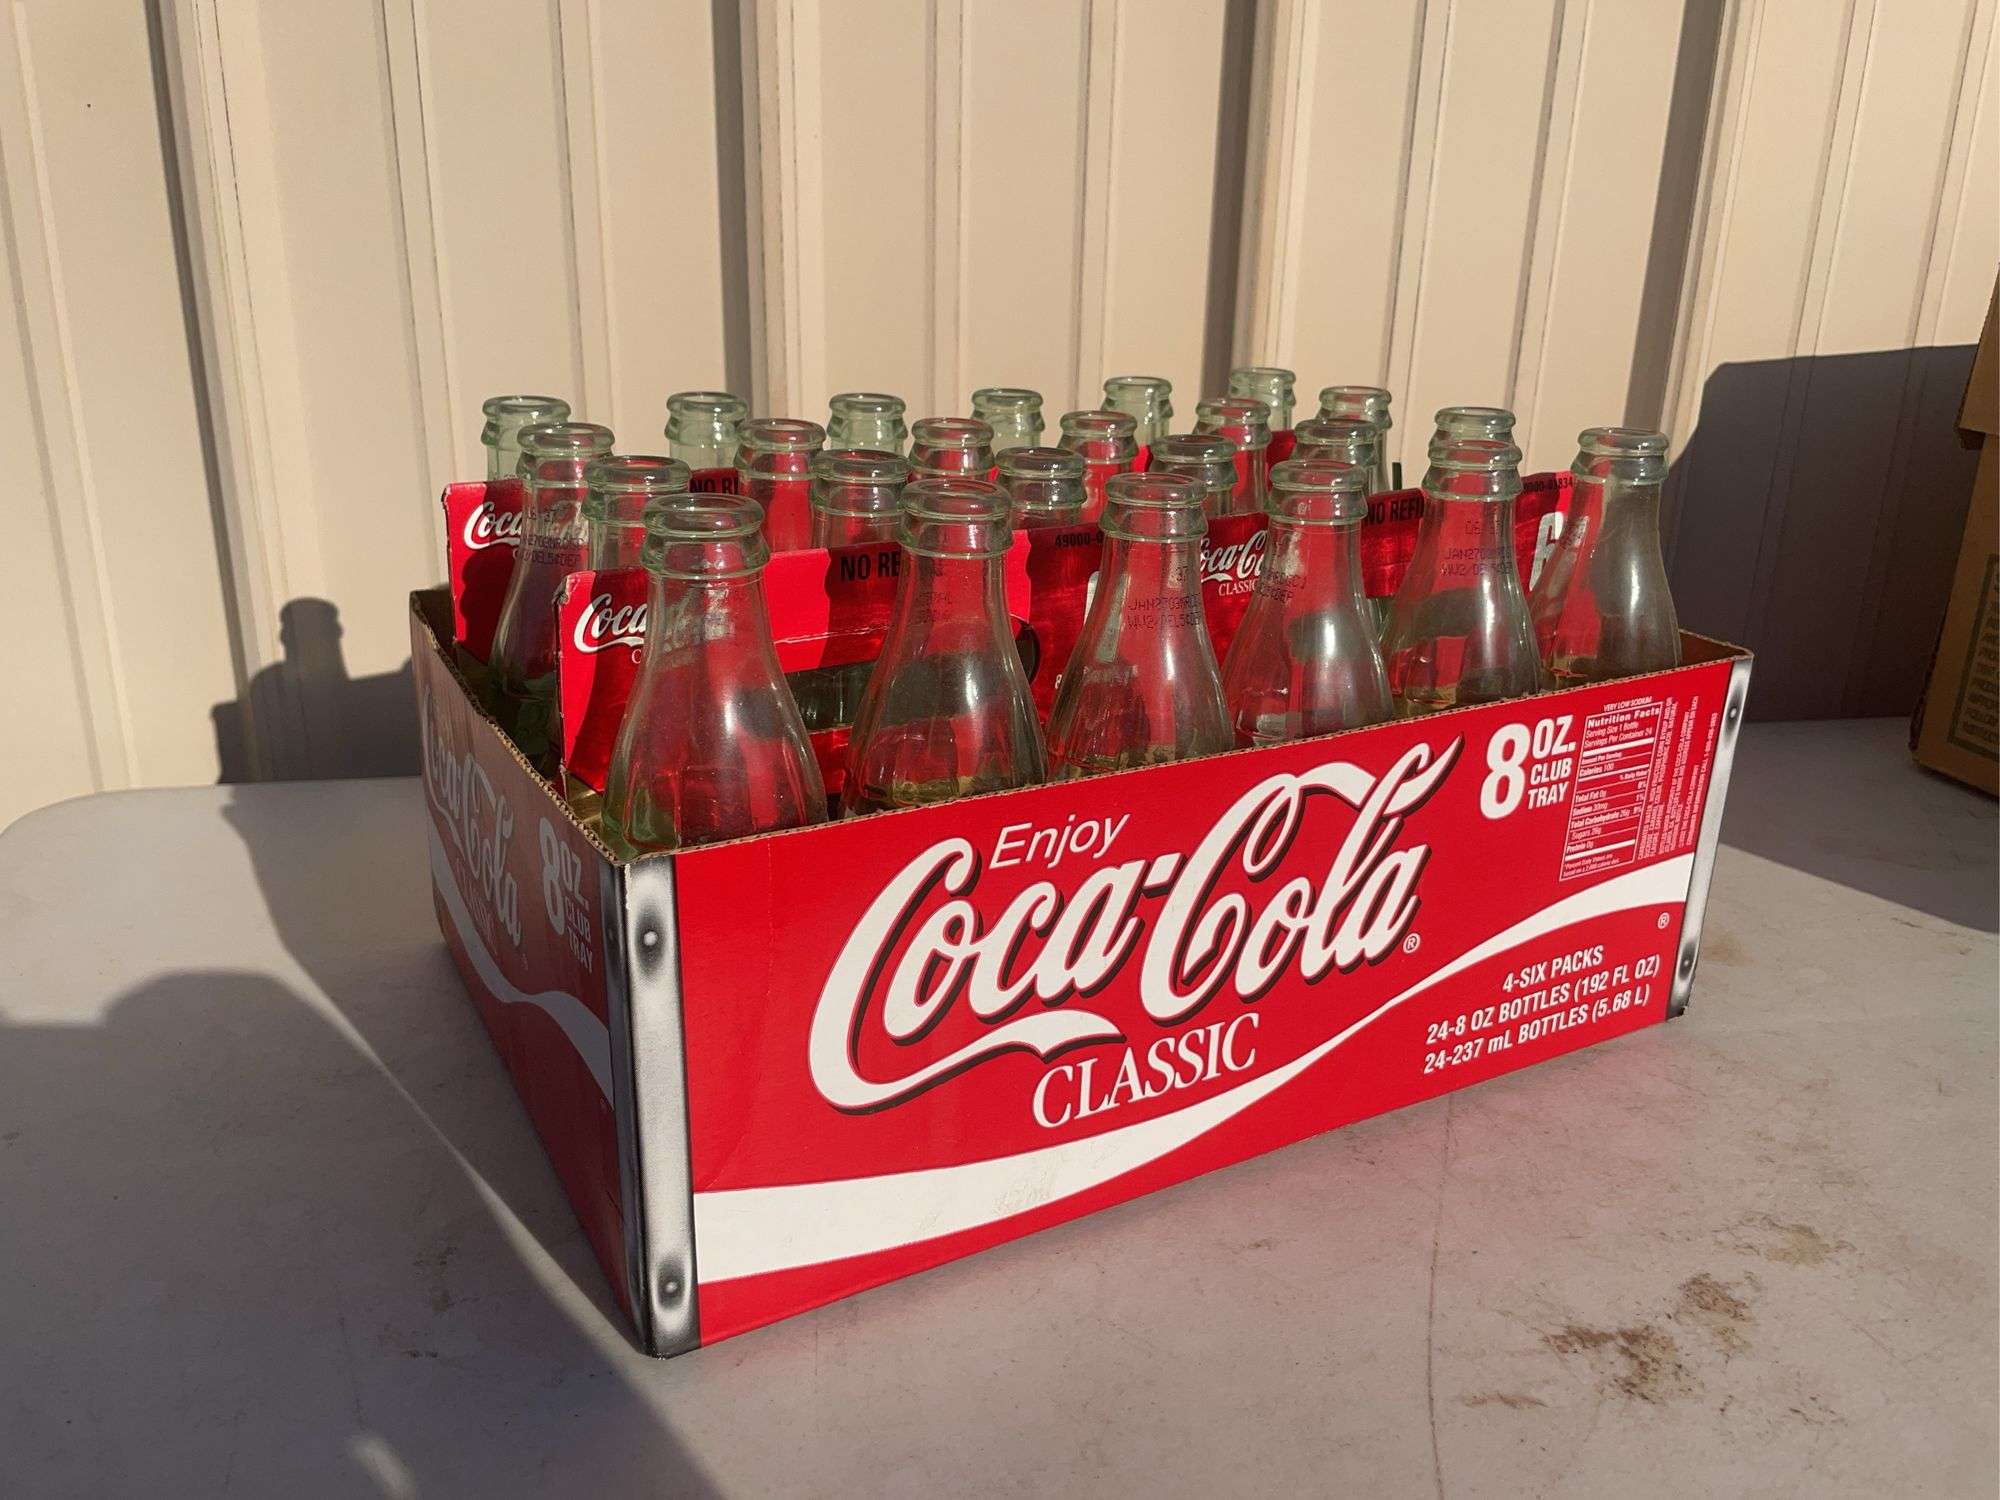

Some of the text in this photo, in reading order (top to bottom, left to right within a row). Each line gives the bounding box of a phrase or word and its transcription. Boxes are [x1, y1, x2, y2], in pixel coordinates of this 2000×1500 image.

[841, 554, 871, 582] NO
[1586, 728, 1607, 739] Serving
[1588, 707, 1661, 729] Nutrition Facts
[1584, 737, 1608, 748] Servings
[1480, 715, 1577, 820] 8 OZ.
[1530, 757, 1571, 786] CLUB
[1528, 781, 1570, 810] TRAY
[989, 812, 1130, 870] Enjoy
[540, 817, 565, 936] 8
[566, 897, 592, 943] CLUB
[808, 732, 1464, 1113] Coca-Cola
[568, 926, 593, 974] TRAY
[1503, 945, 1604, 993] 4-SIX PACKS
[1426, 954, 1661, 1045] 24-8 OZ BOTTLES (192 FL OZ)
[1423, 984, 1650, 1074] 24-237 mL BOTTLES (5.68 L)
[1032, 1012, 1260, 1128] CLASSIC
